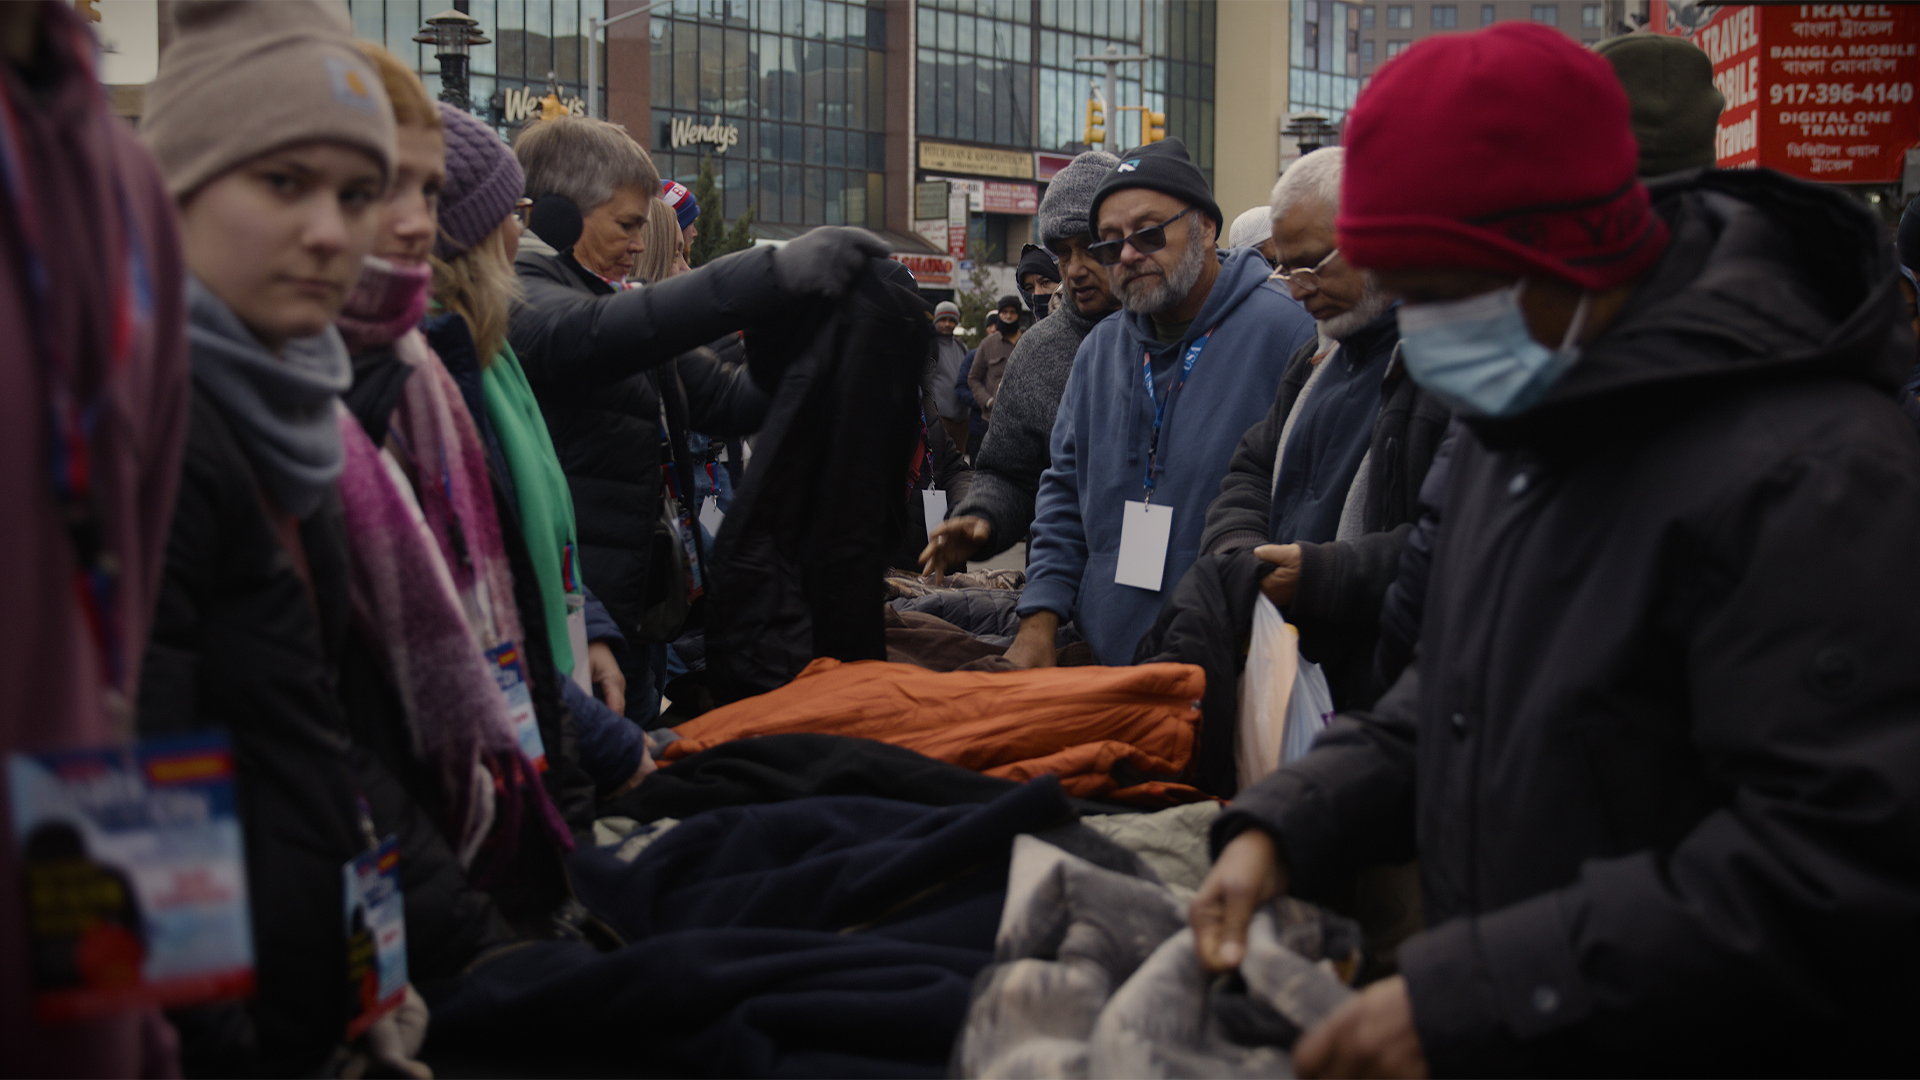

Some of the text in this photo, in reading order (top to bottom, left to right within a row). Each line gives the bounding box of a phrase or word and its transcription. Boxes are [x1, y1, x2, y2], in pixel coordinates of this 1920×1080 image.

[1800, 4, 1892, 19] TRAVEL
[1701, 5, 1758, 66] TRAVEL
[1791, 21, 1837, 38] বাংলা
[1769, 43, 1917, 59] BANGLA MOBILE
[1712, 56, 1758, 112] OBILE
[1769, 82, 1914, 105] 917-396-4140
[505, 86, 586, 123] Wey's
[1779, 110, 1893, 124] DIGITAL ONE
[671, 114, 739, 154] Wendy's
[1800, 124, 1870, 137] TRAVEL
[1184, 346, 1202, 371] USA
